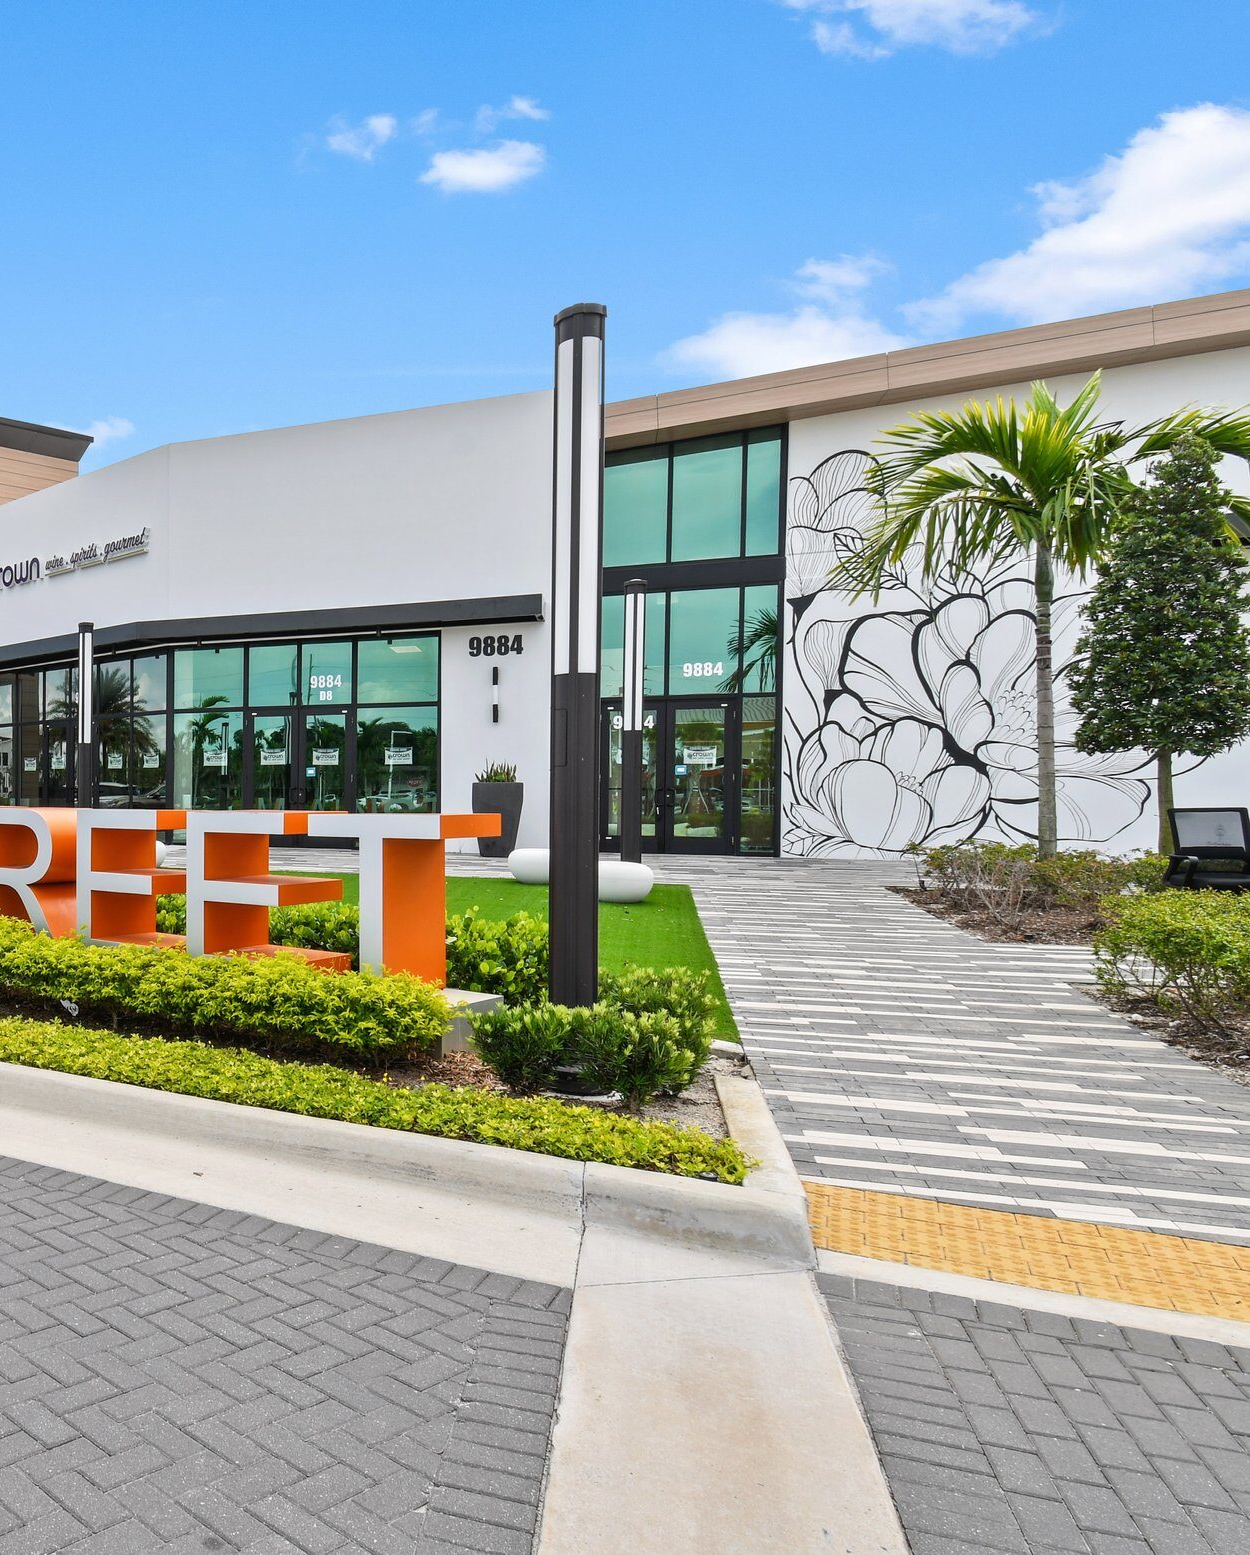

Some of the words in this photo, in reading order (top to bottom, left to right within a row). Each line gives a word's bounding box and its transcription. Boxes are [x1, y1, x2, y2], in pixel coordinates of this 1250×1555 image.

[45, 555, 64, 571] wine
[70, 543, 97, 568] spirits
[103, 527, 146, 562] gourmet
[468, 634, 524, 658] 9884
[682, 661, 724, 678] 9884
[310, 675, 342, 689] 9884
[612, 715, 655, 729] 94
